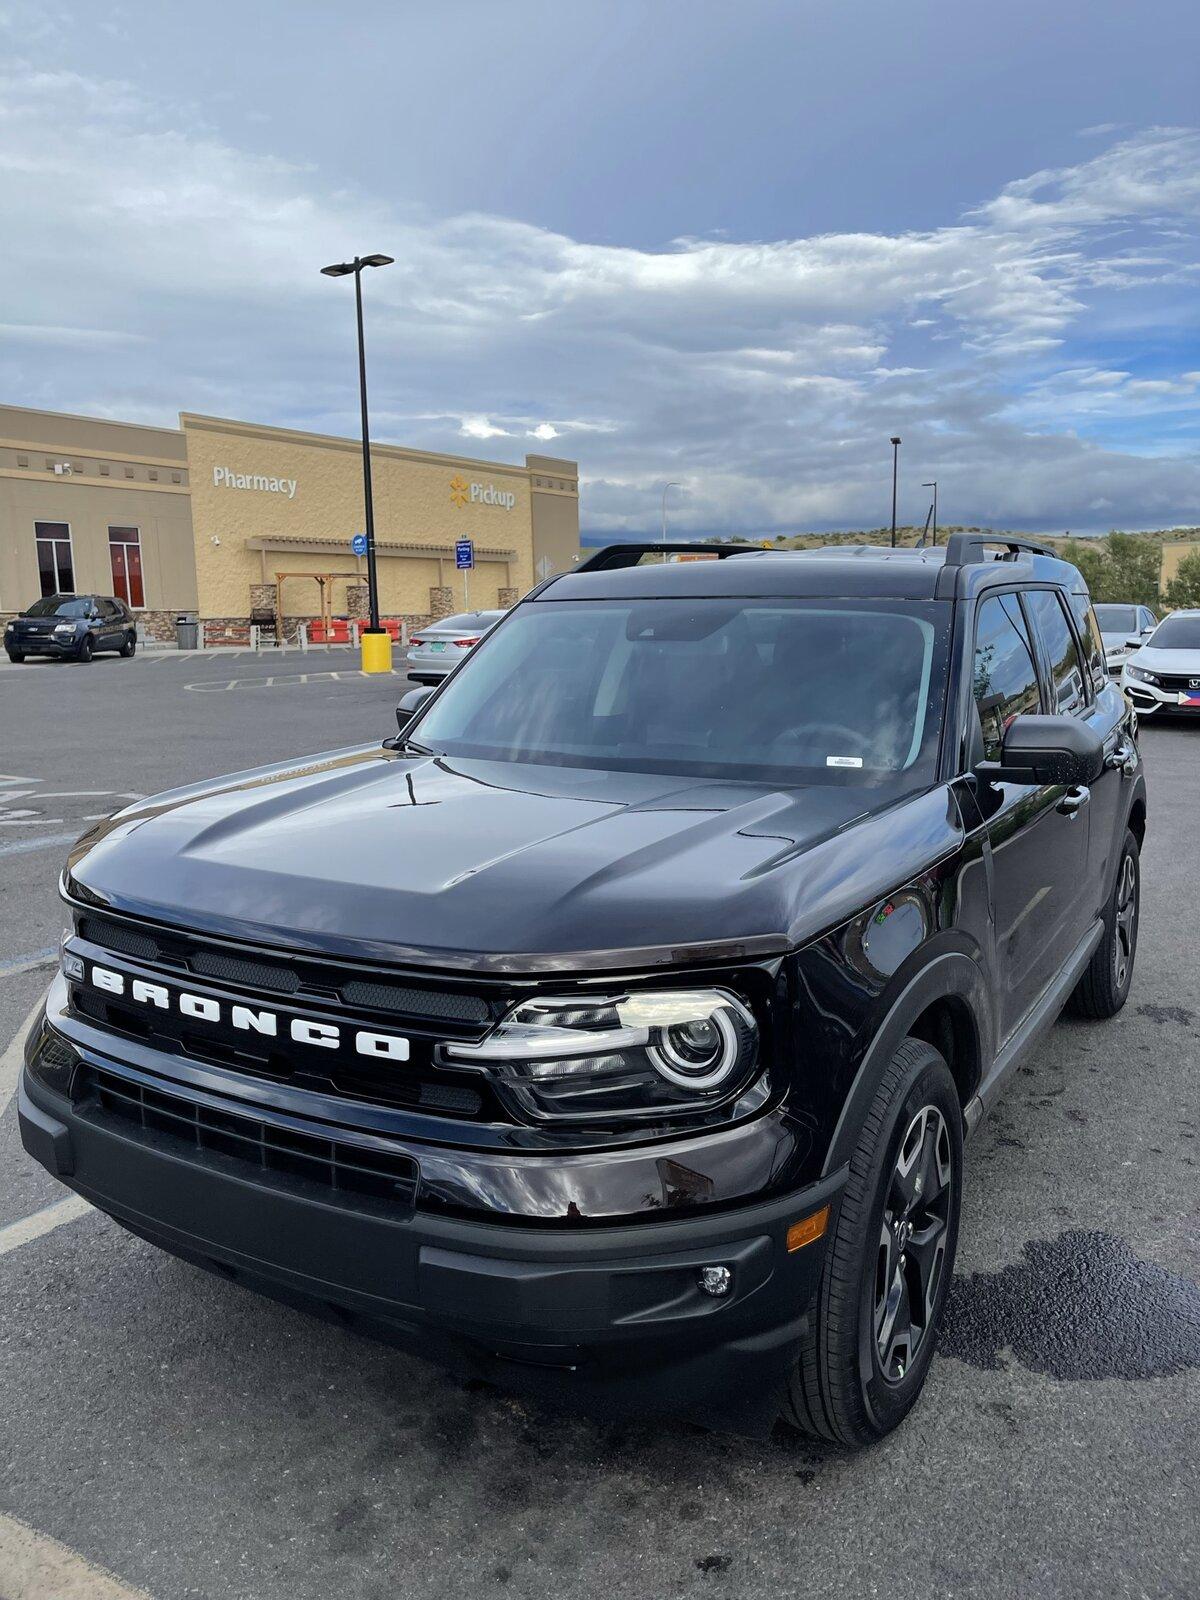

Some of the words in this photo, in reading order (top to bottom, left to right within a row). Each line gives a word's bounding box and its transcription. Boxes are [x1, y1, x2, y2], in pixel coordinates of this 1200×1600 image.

[213, 466, 297, 499] Pharmacy
[470, 483, 515, 511] Pickup
[92, 966, 410, 1061] BRONCO
